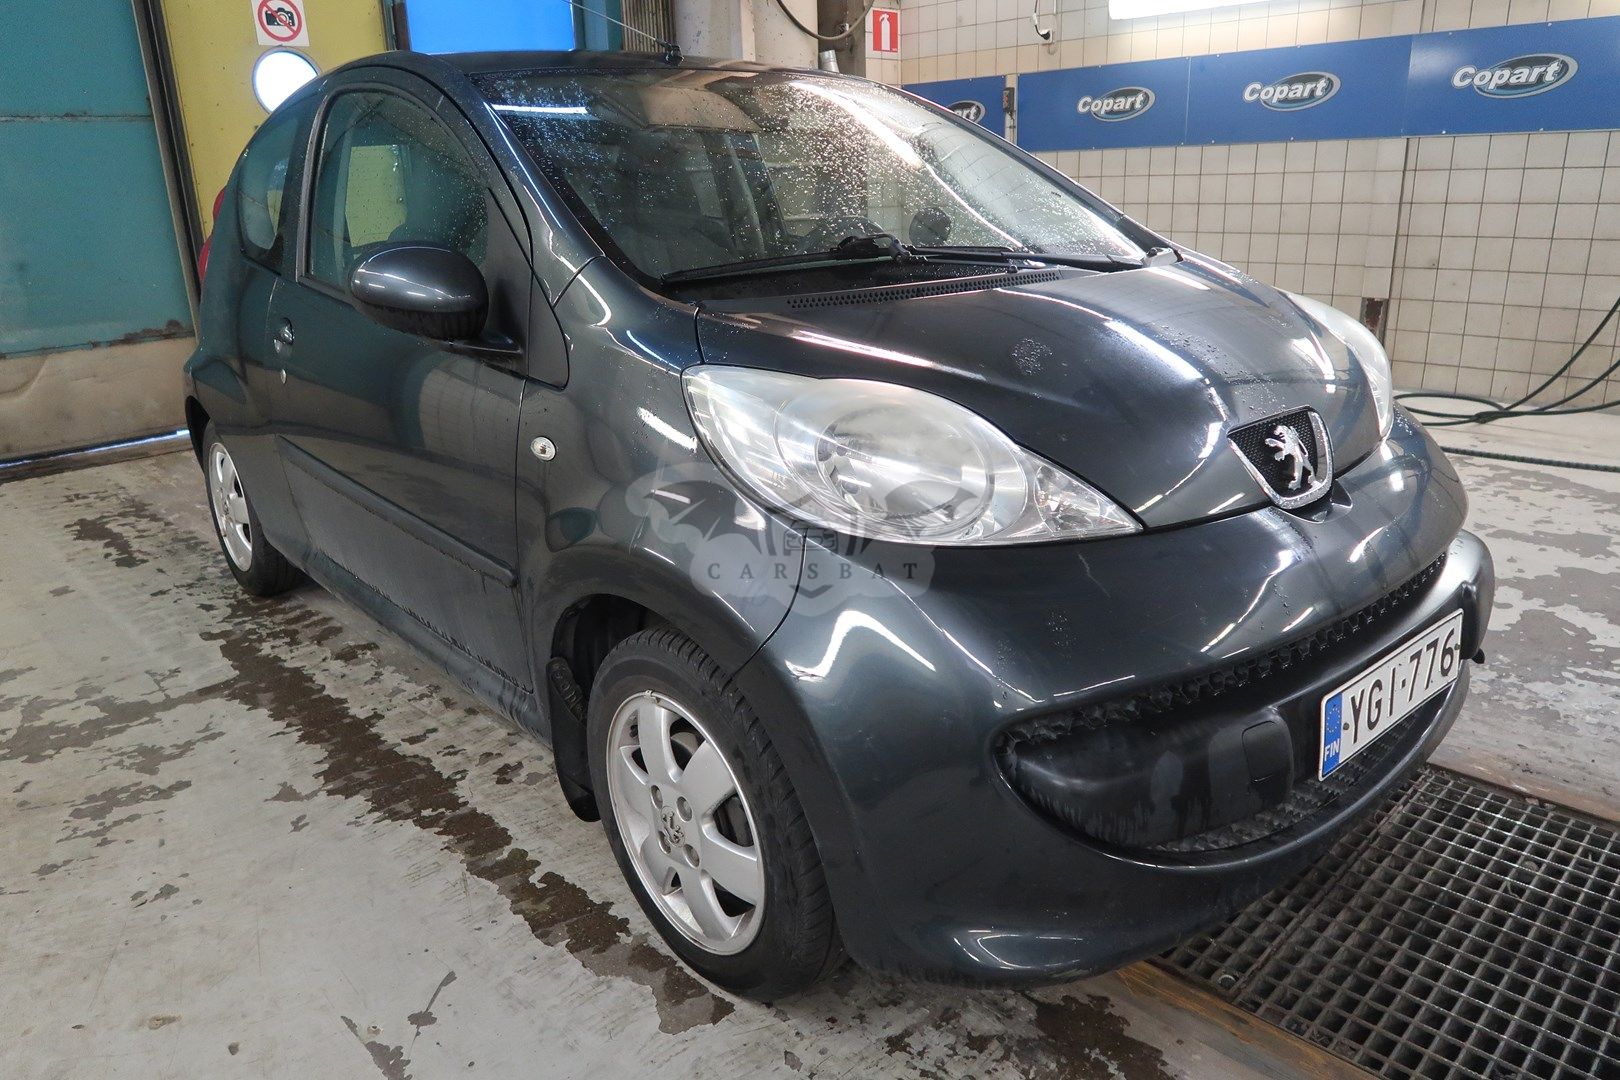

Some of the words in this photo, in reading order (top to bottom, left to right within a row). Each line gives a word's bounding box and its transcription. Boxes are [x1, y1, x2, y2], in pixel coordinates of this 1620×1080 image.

[1452, 61, 1560, 90] Copart
[1077, 93, 1145, 115] Copart
[1244, 78, 1328, 104] Copart
[1350, 628, 1455, 745] YGI-776
[1324, 738, 1341, 762] FIN
